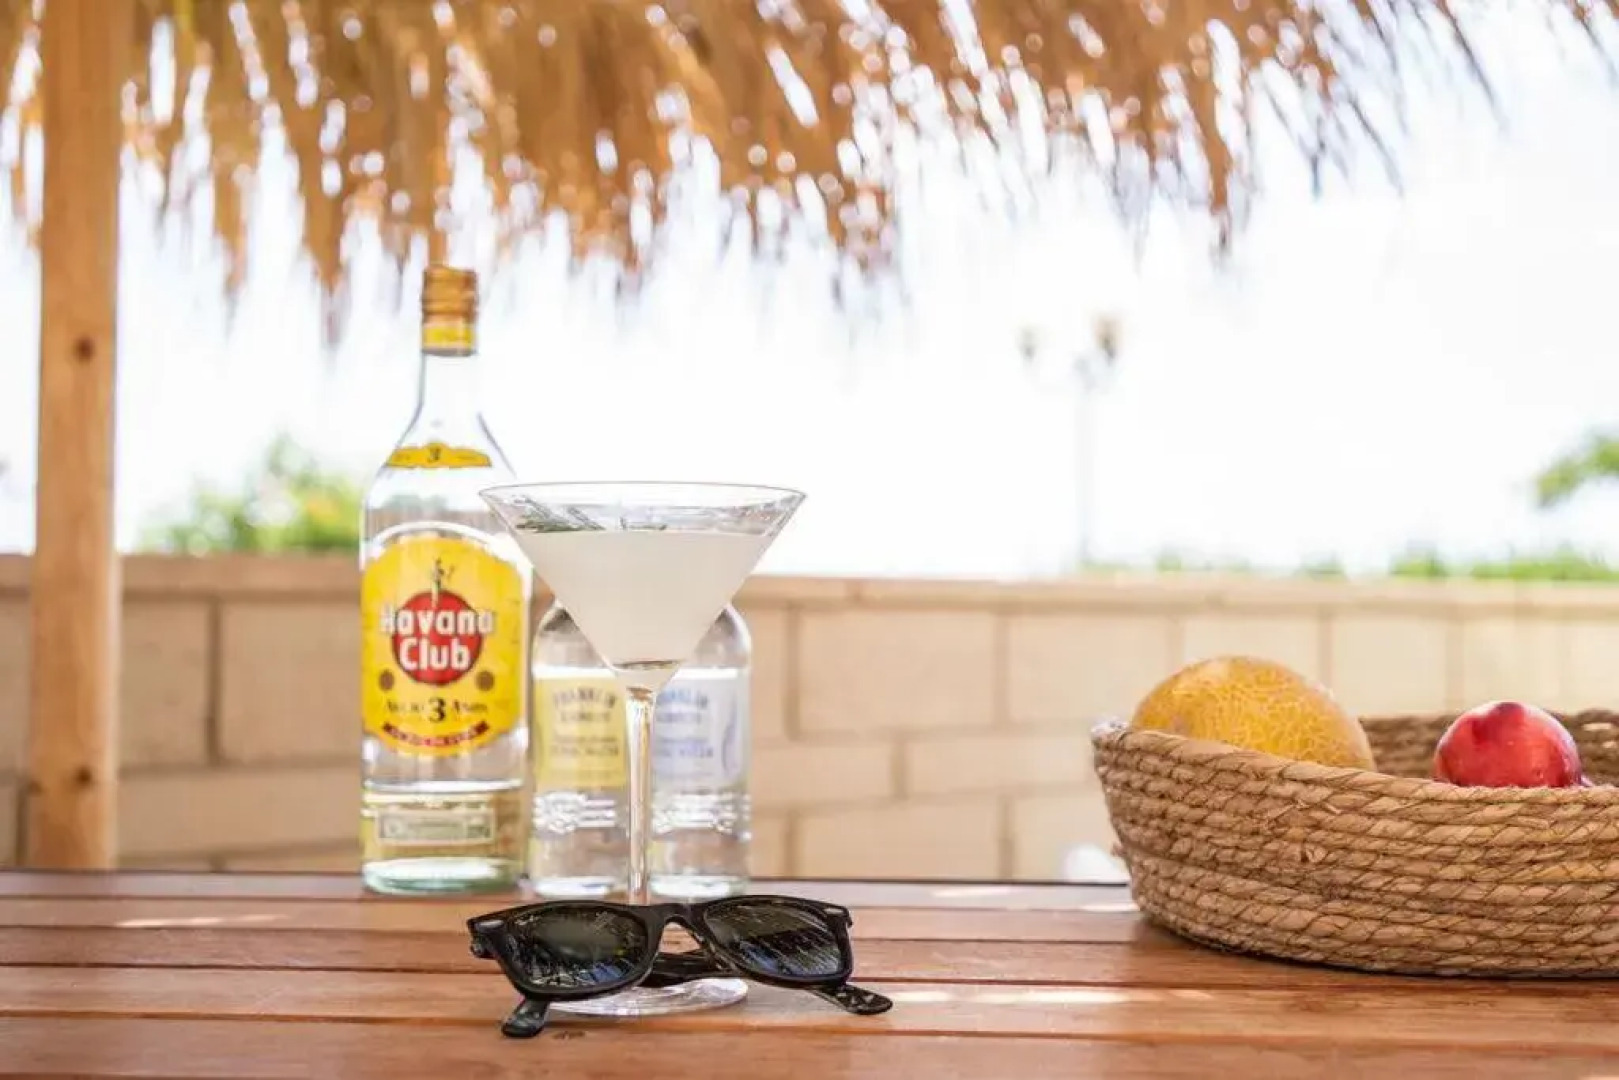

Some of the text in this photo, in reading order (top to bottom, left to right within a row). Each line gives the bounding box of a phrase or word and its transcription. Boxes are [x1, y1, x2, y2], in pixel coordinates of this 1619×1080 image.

[380, 604, 496, 635] Havana
[400, 637, 471, 671] Club
[428, 697, 446, 723] 3
